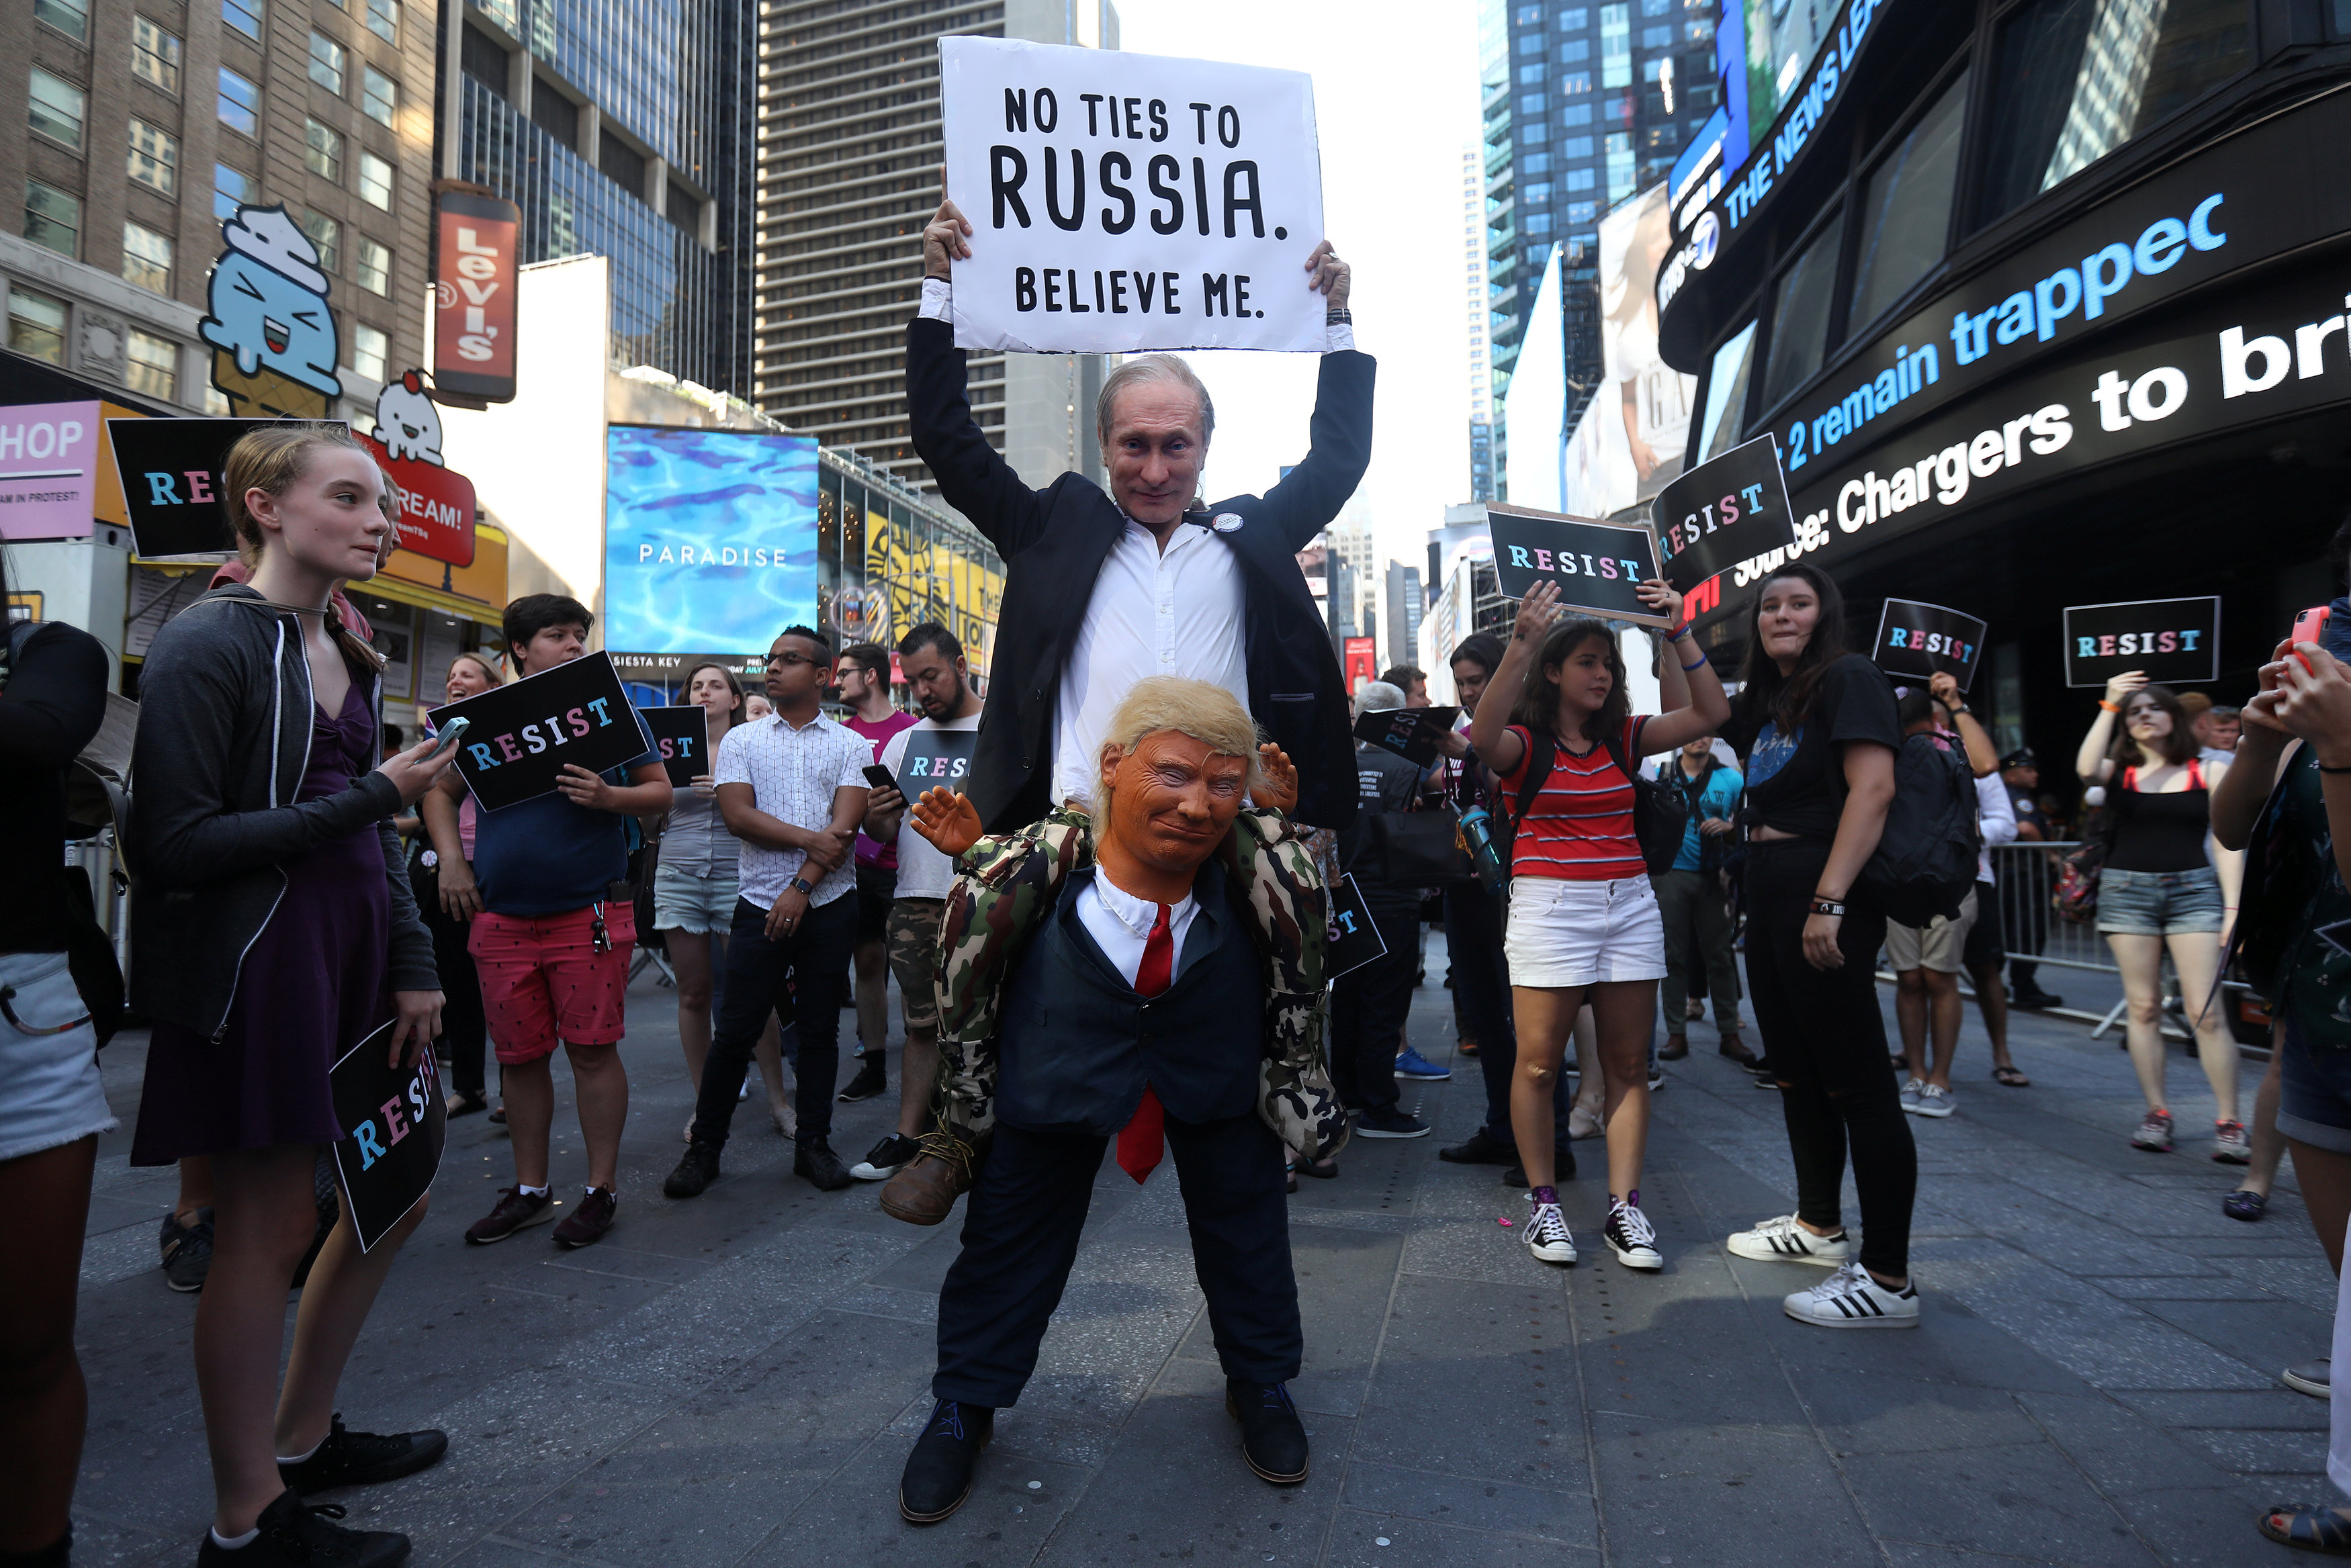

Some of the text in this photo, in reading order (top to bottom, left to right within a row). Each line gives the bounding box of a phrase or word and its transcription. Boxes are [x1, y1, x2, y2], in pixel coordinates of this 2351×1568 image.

[1004, 87, 1241, 148] NO TIES TO
[1724, 150, 1773, 230] THE
[1774, 50, 1840, 175] NEWS
[990, 144, 1288, 240] RUSSIA.
[1016, 267, 1264, 319] BELIEVE ME.
[1789, 421, 1808, 472] 2
[1813, 344, 1940, 456] remain
[1836, 403, 2074, 534] Chargers
[2091, 365, 2189, 432] to
[144, 471, 228, 506] RE
[1658, 482, 1765, 566] RESIST
[639, 543, 787, 567] PARADISE
[1507, 544, 1640, 583] RESIST
[613, 655, 681, 668] SIESTA KEY
[1888, 627, 1973, 663] RESIST
[2076, 629, 2202, 658] RESIST
[745, 665, 763, 674] JULY
[467, 696, 613, 772] RESIST
[1385, 711, 1421, 750] RESI
[910, 756, 970, 778] RES
[353, 1044, 434, 1172] RESIST
